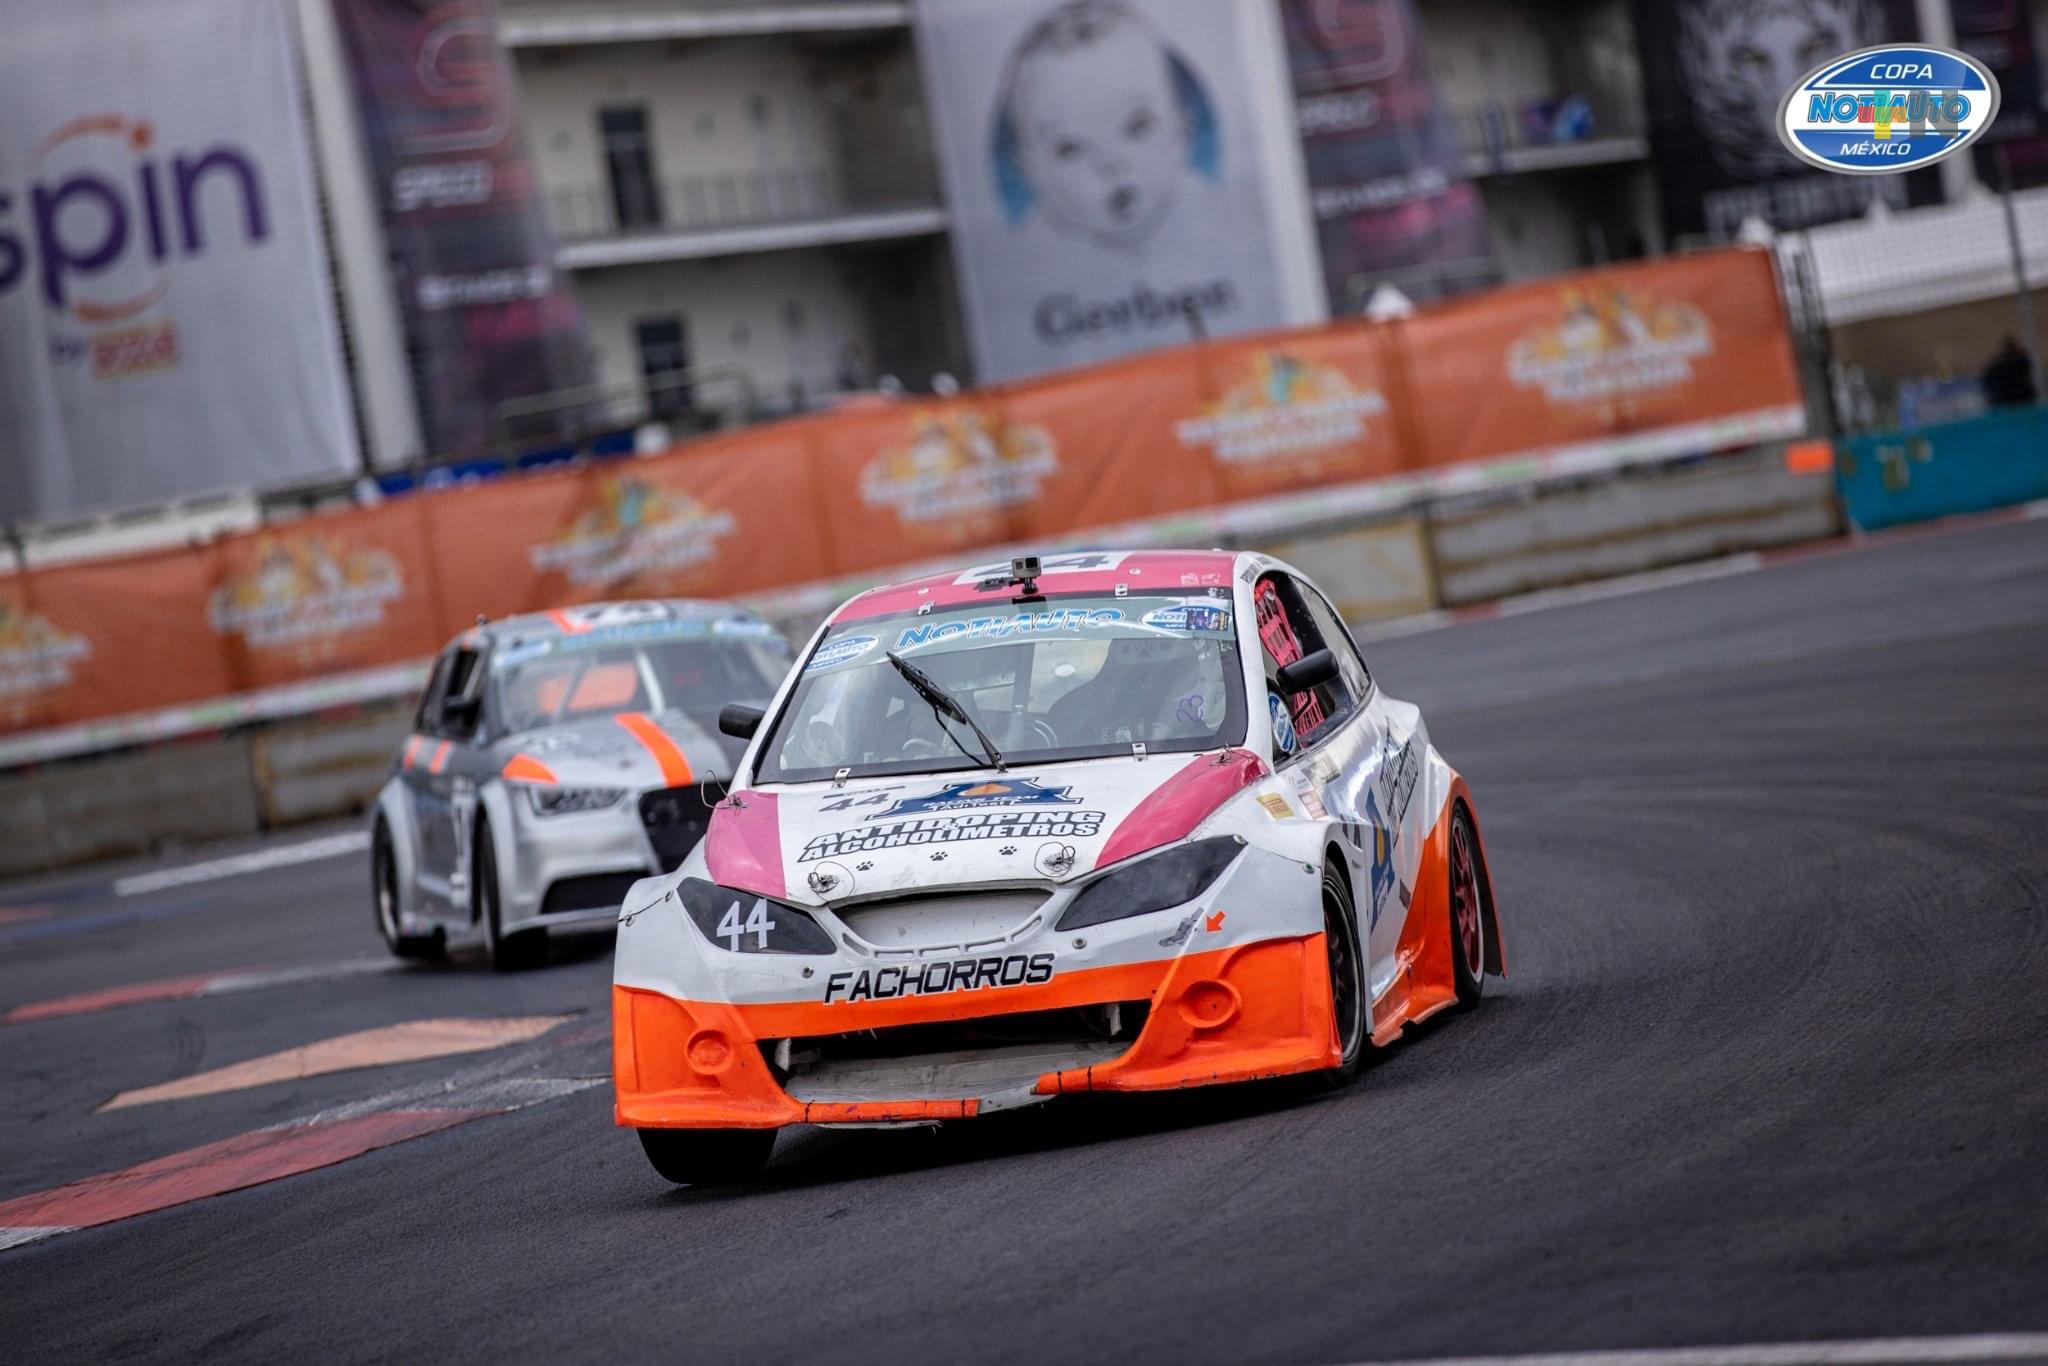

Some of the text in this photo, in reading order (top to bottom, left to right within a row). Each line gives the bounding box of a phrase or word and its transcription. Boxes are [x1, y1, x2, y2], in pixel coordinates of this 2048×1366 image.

[893, 608, 1126, 650] NOTIAUTO
[819, 793, 890, 813] 44
[797, 821, 1101, 863] ALCOHOLIMETROS
[804, 810, 1106, 850] ANTIDOPING
[716, 898, 776, 952] 44
[824, 953, 1055, 1004] FACHORROS
